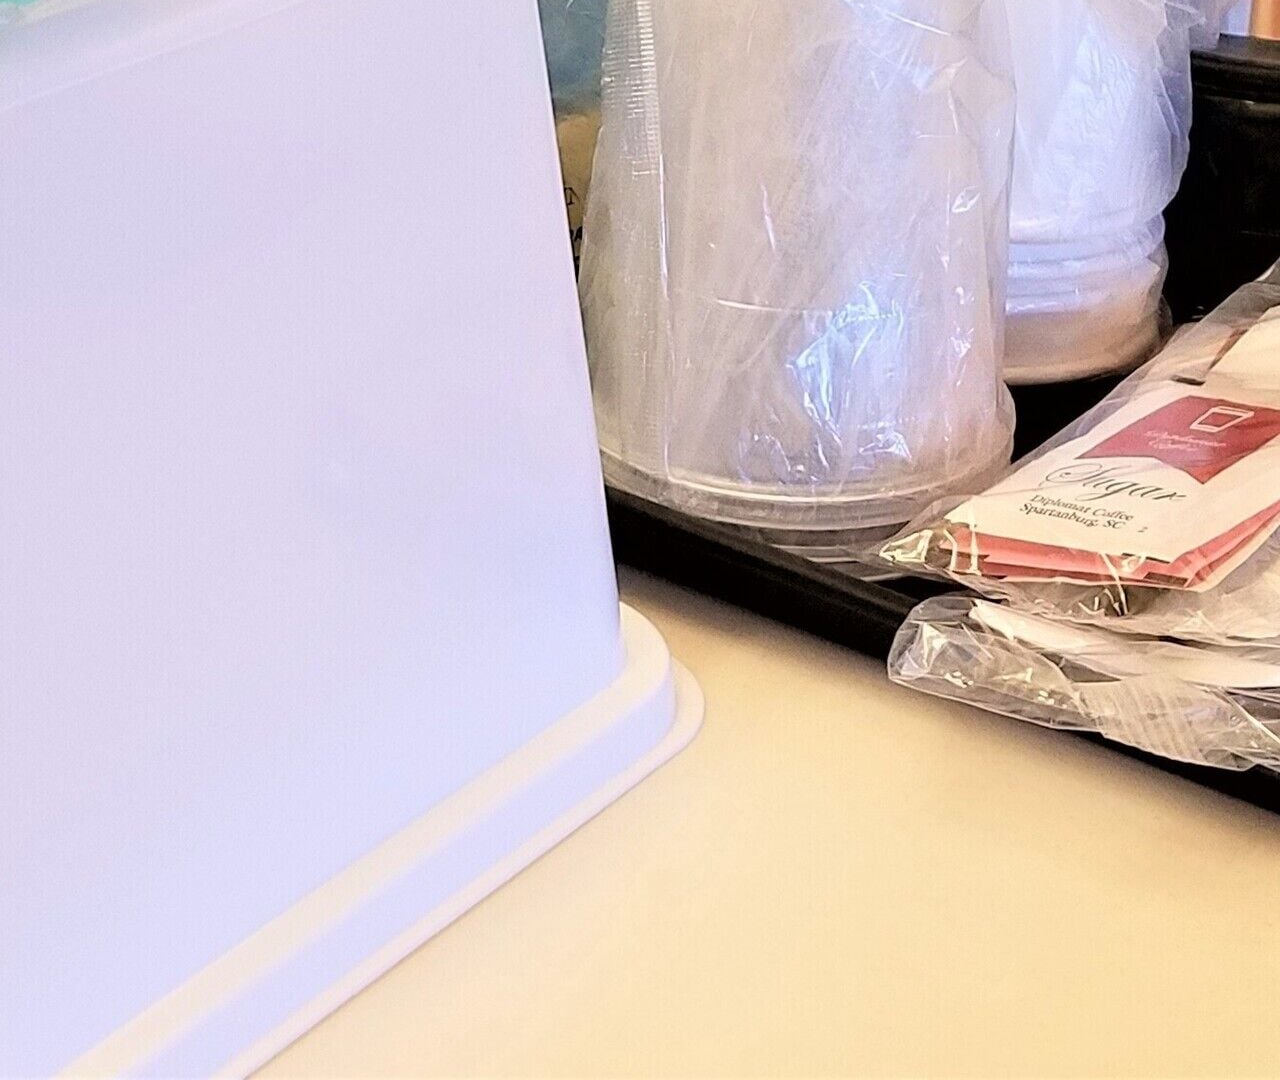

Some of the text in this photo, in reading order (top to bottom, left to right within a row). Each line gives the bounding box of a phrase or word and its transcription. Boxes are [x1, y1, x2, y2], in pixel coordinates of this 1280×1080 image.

[1038, 463, 1187, 502] Sugar
[1029, 494, 1134, 522] Diplomat Coffee
[1103, 519, 1127, 530] SC
